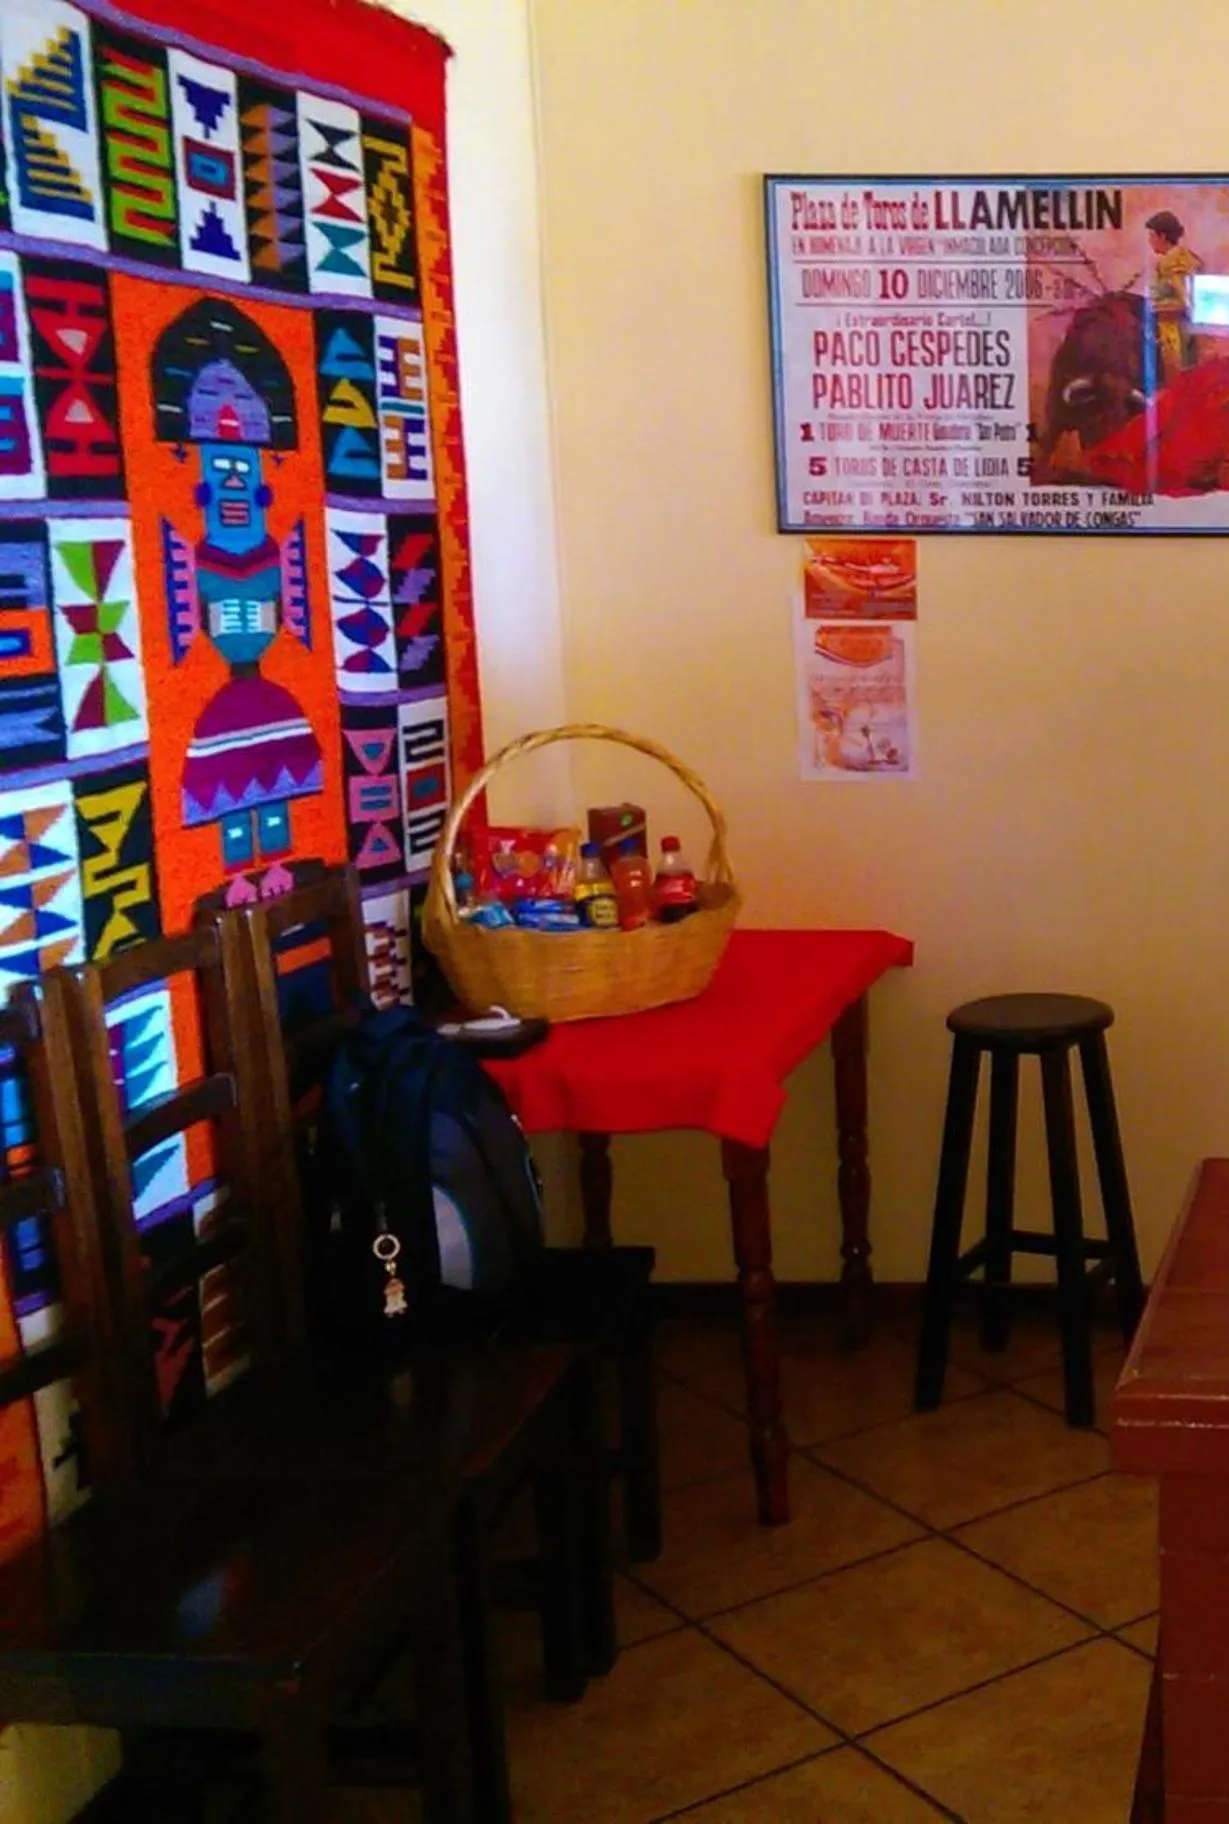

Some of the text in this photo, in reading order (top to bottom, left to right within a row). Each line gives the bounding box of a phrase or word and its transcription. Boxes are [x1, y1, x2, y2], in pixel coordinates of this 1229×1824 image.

[791, 189, 1122, 231] Plaza de Toros de LLAMELLIN
[802, 268, 870, 298] DOMINGO
[878, 268, 909, 299] 10
[918, 269, 998, 299] DICIEMBRE
[814, 331, 1010, 367] PACO CESPEDES
[812, 374, 1014, 409] PABLITO JUAREZ
[800, 422, 814, 442] 1
[879, 423, 930, 441] MUERTE
[809, 456, 1033, 477] 5 TOROS DE CASTA DE LIDIA 5
[1023, 492, 1079, 506] TORRES
[1086, 492, 1094, 506] Y
[1102, 492, 1155, 506] FAMILIA
